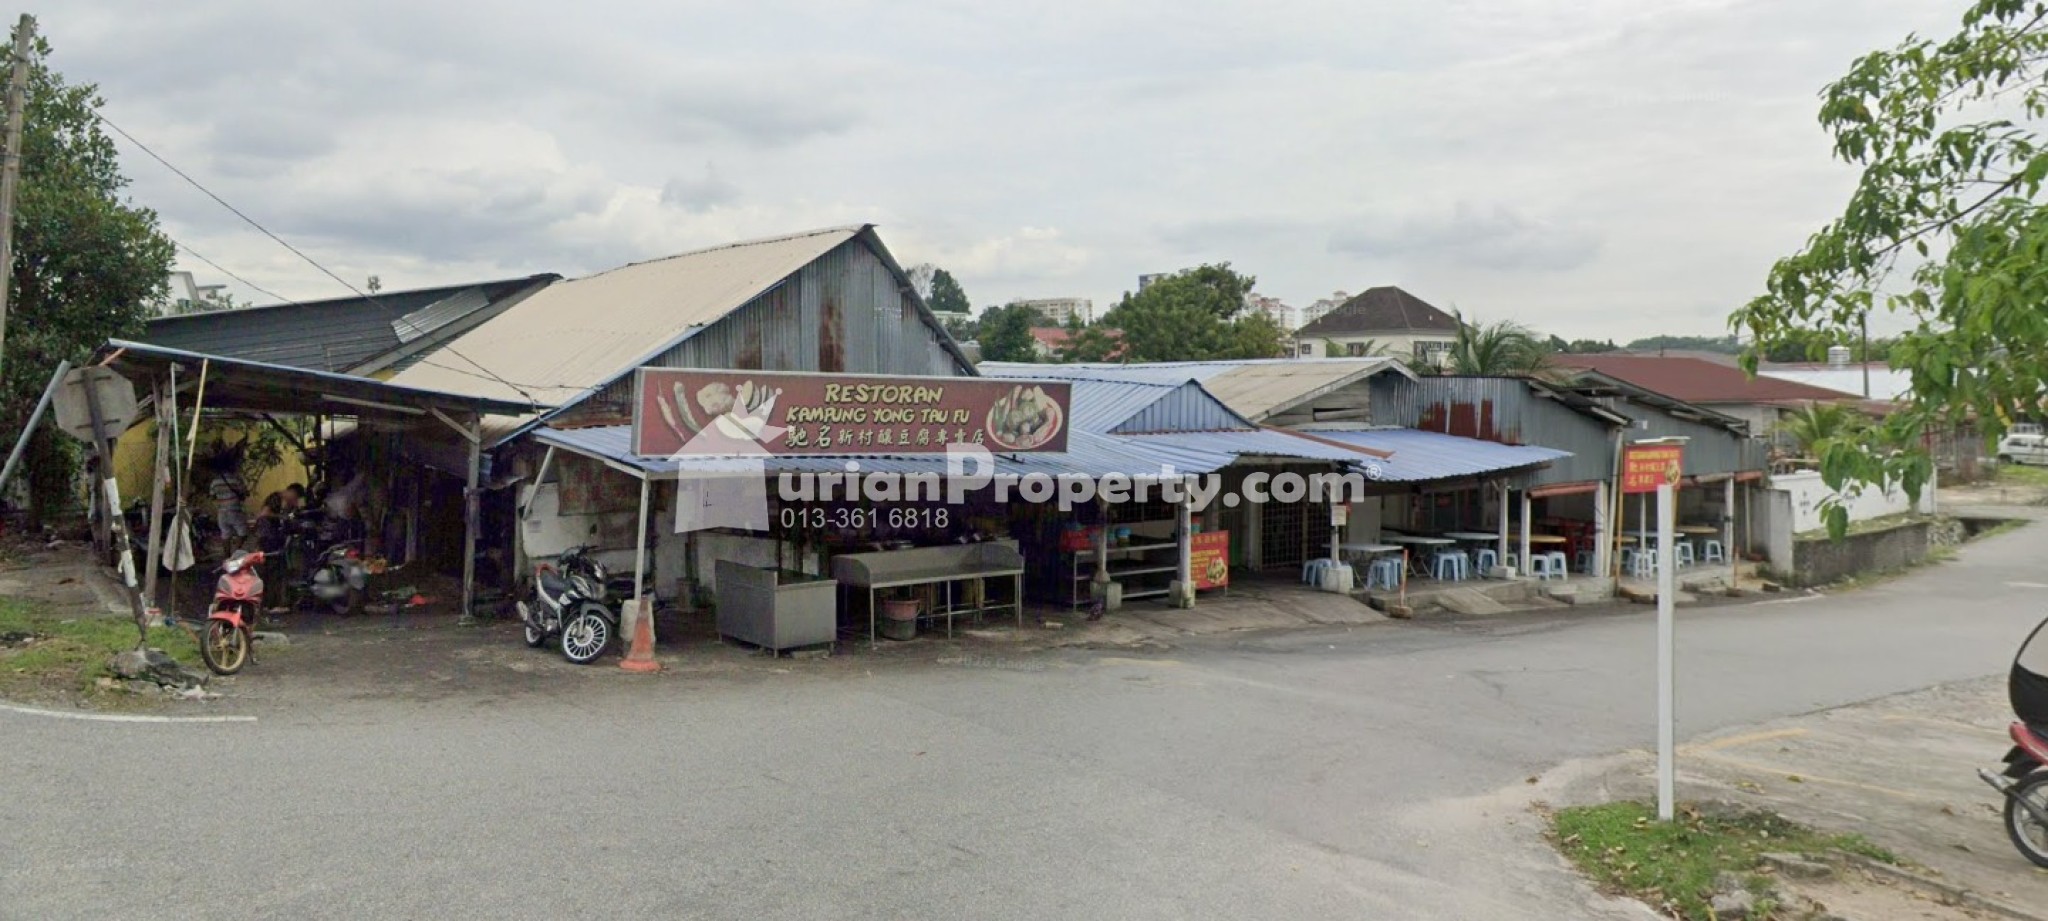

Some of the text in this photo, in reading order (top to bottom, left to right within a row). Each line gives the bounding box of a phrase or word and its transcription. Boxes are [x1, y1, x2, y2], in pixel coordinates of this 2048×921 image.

[825, 384, 943, 404] RESTORAN
[786, 407, 970, 424] KAMPUNG YONG TAU FU
